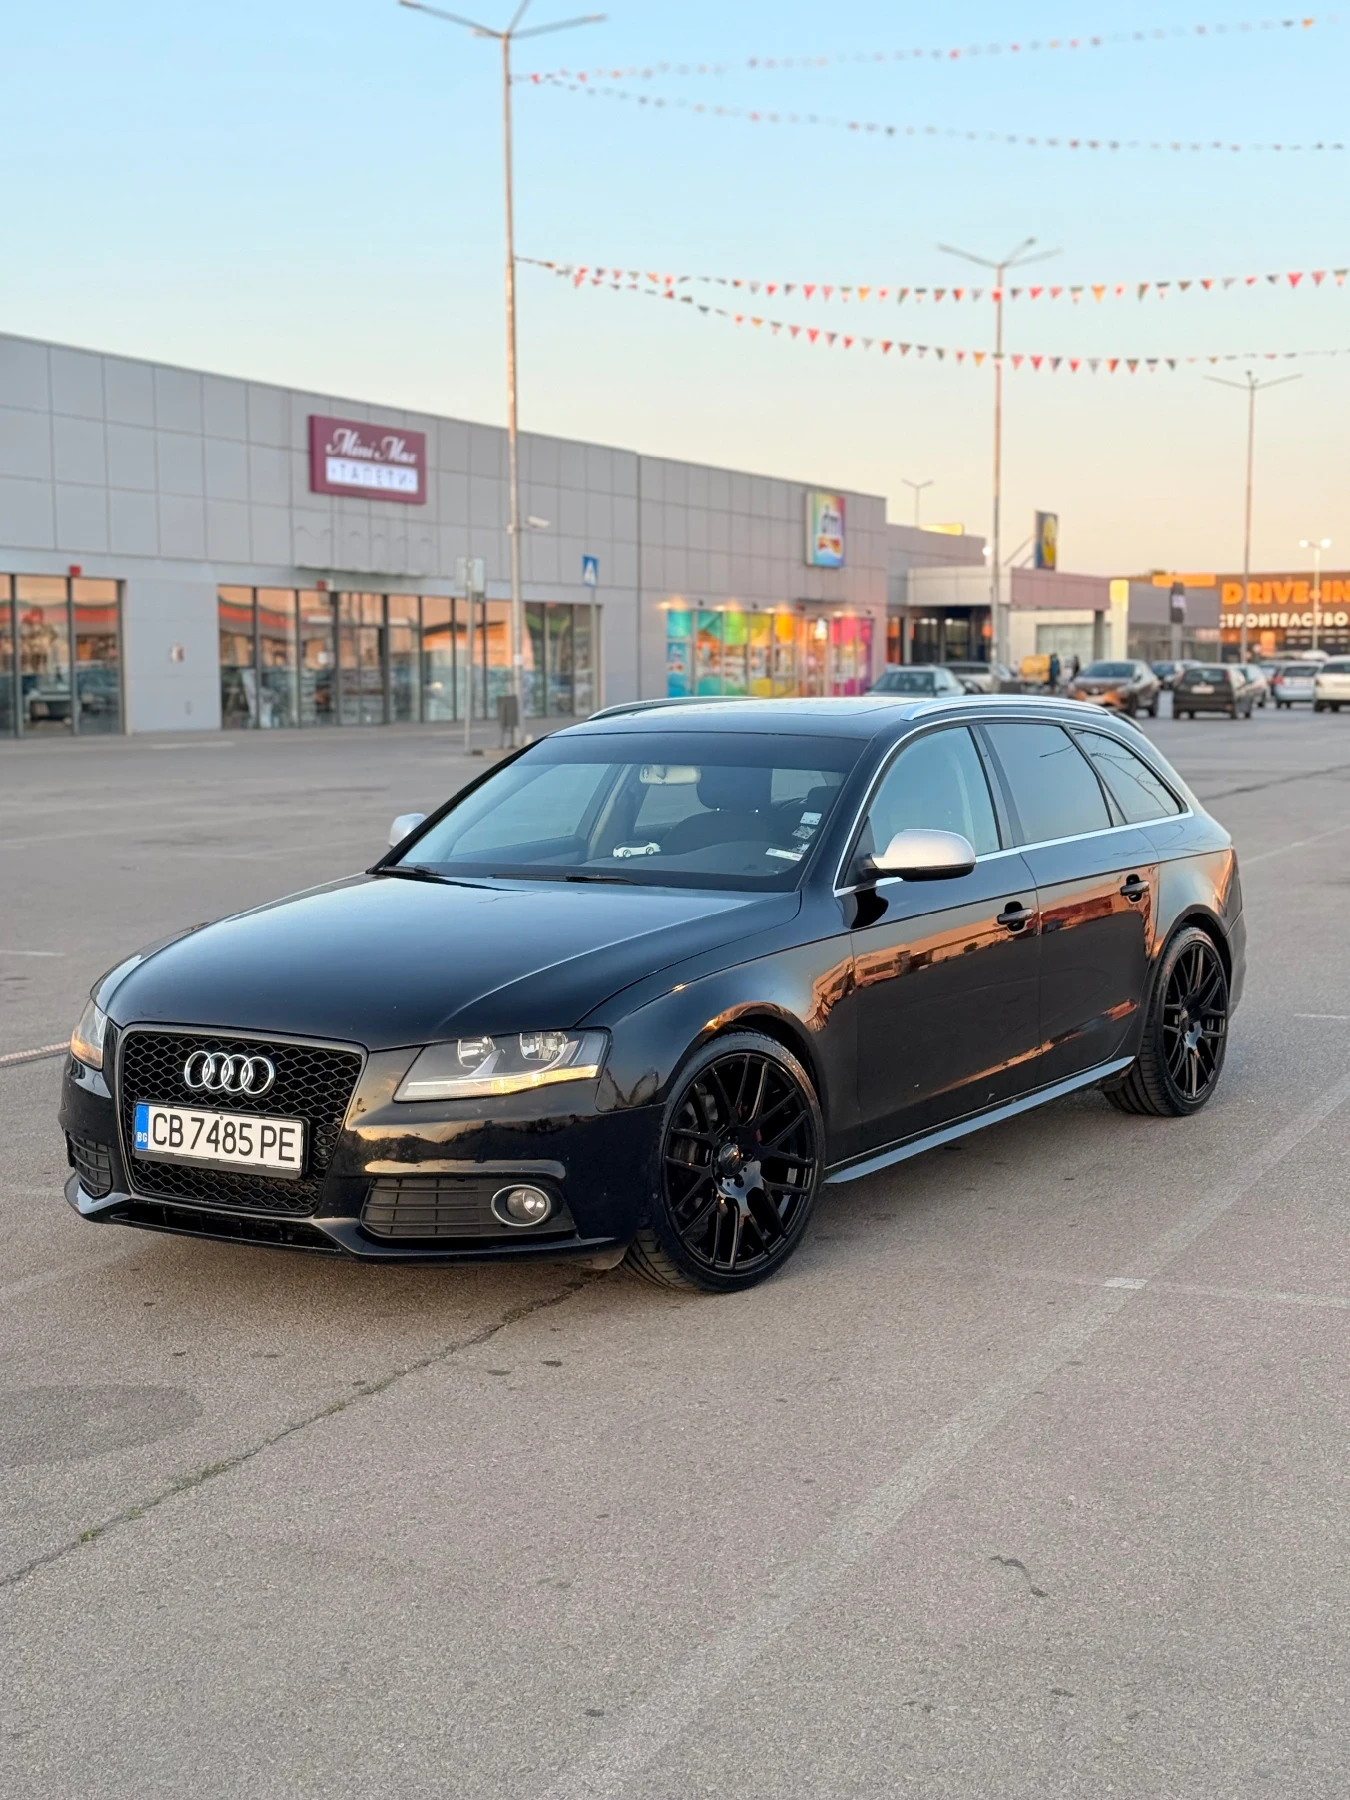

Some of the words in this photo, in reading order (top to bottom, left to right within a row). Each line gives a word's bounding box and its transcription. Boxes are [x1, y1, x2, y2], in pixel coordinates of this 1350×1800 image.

[325, 428, 374, 459] Mini
[136, 1132, 148, 1143] BG
[152, 1112, 184, 1148] CB
[190, 1116, 254, 1156] 7485
[260, 1124, 296, 1163] PE
